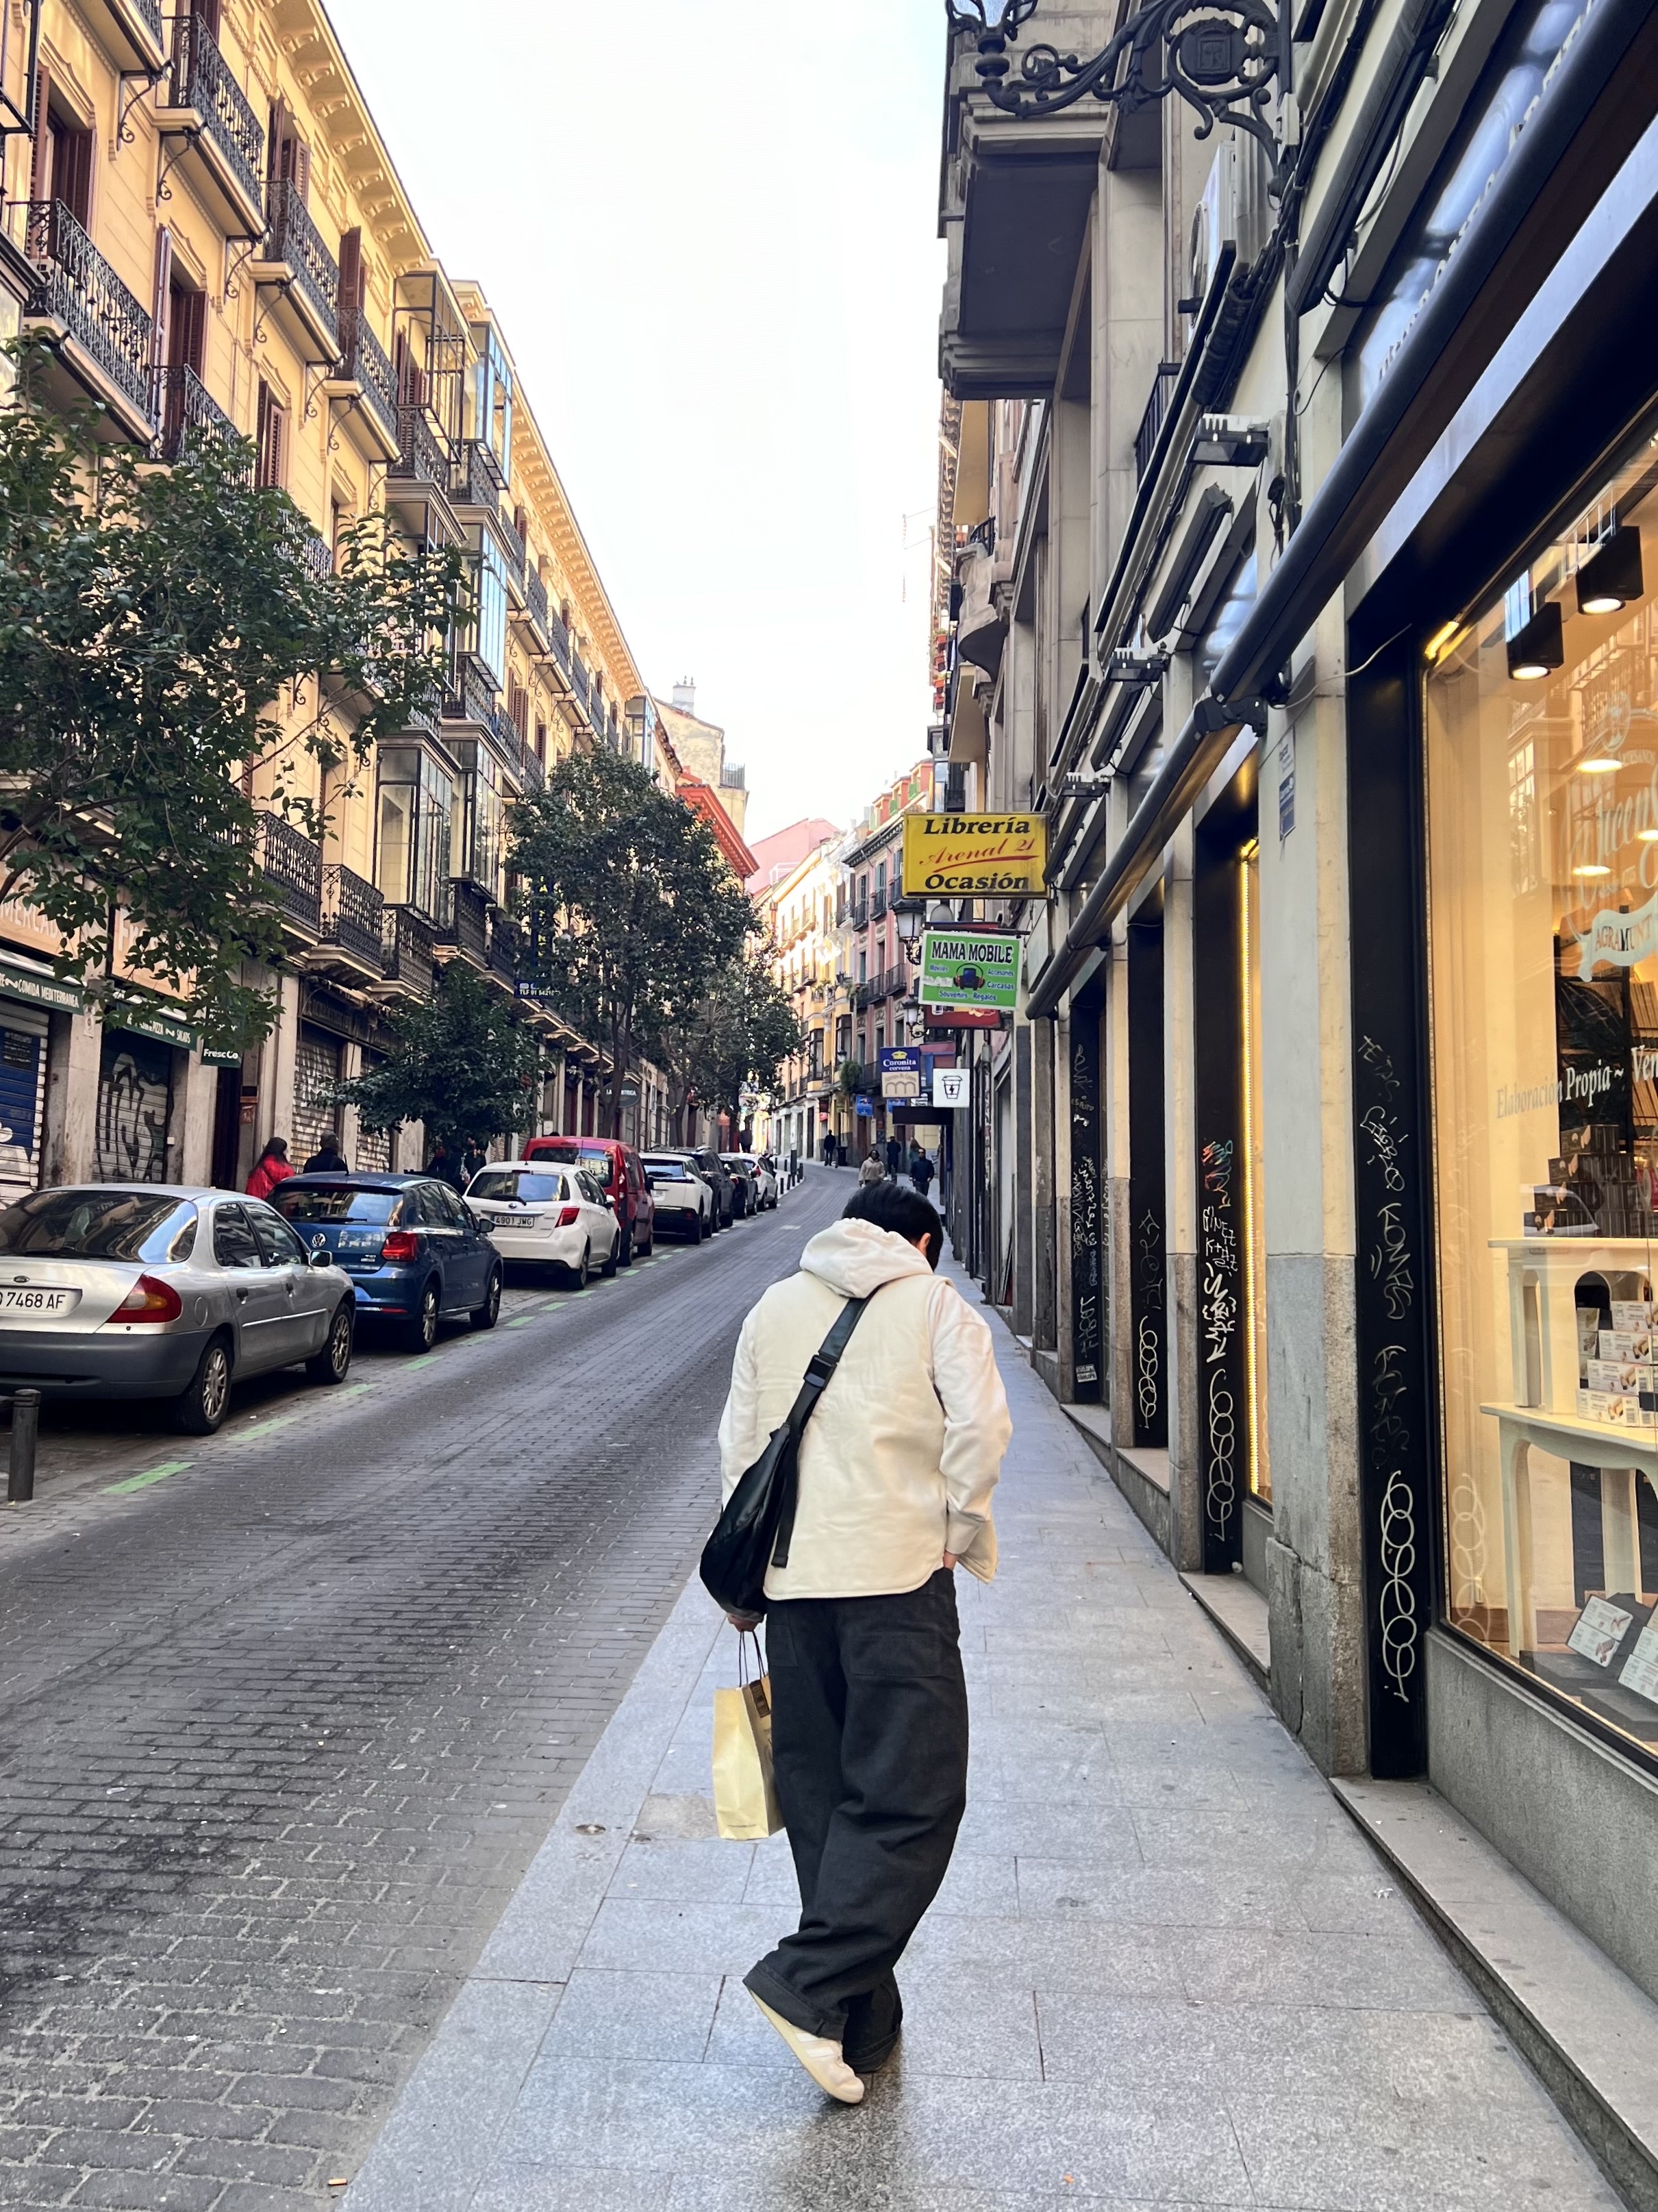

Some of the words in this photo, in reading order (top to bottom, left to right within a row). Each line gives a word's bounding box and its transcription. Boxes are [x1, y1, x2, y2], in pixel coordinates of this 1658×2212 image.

[923, 817, 1031, 834] Librería
[919, 838, 1009, 865] Arenal
[1014, 838, 1035, 852] 21
[925, 872, 1030, 890] Ocasión
[931, 941, 966, 960] MAMA
[968, 943, 1013, 964] MOBILE
[18, 979, 40, 997] COMIDA
[987, 981, 1014, 990] Carcasas
[939, 990, 968, 999] Souvenirs
[972, 992, 996, 1002] Regalos
[883, 1058, 916, 1067] Coronita
[1496, 1073, 1563, 1119] Elaboración
[1566, 1059, 1612, 1108] Propia
[495, 1216, 515, 1225] 4901
[6, 1291, 44, 1308] 7468
[46, 1293, 66, 1309] AF
